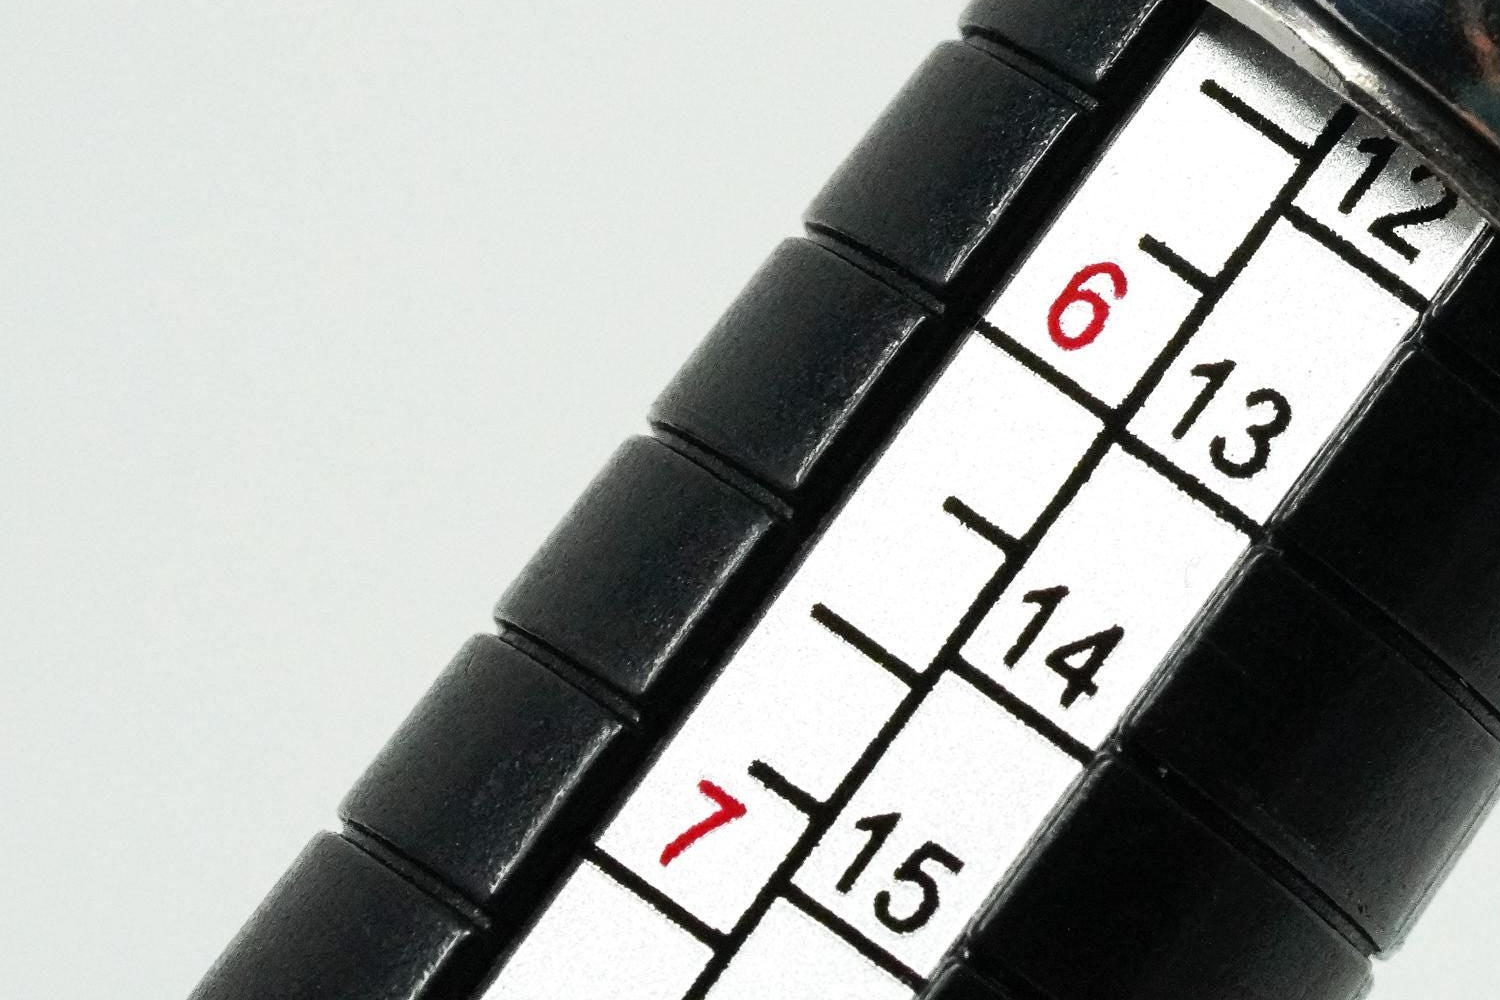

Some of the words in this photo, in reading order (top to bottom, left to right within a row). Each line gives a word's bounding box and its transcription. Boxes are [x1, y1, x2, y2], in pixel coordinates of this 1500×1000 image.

[1338, 135, 1459, 264] 12
[1046, 262, 1128, 351] 6
[1172, 359, 1293, 479] 13
[1002, 585, 1125, 709] 14
[658, 779, 748, 867] 7
[835, 812, 965, 934] 15
